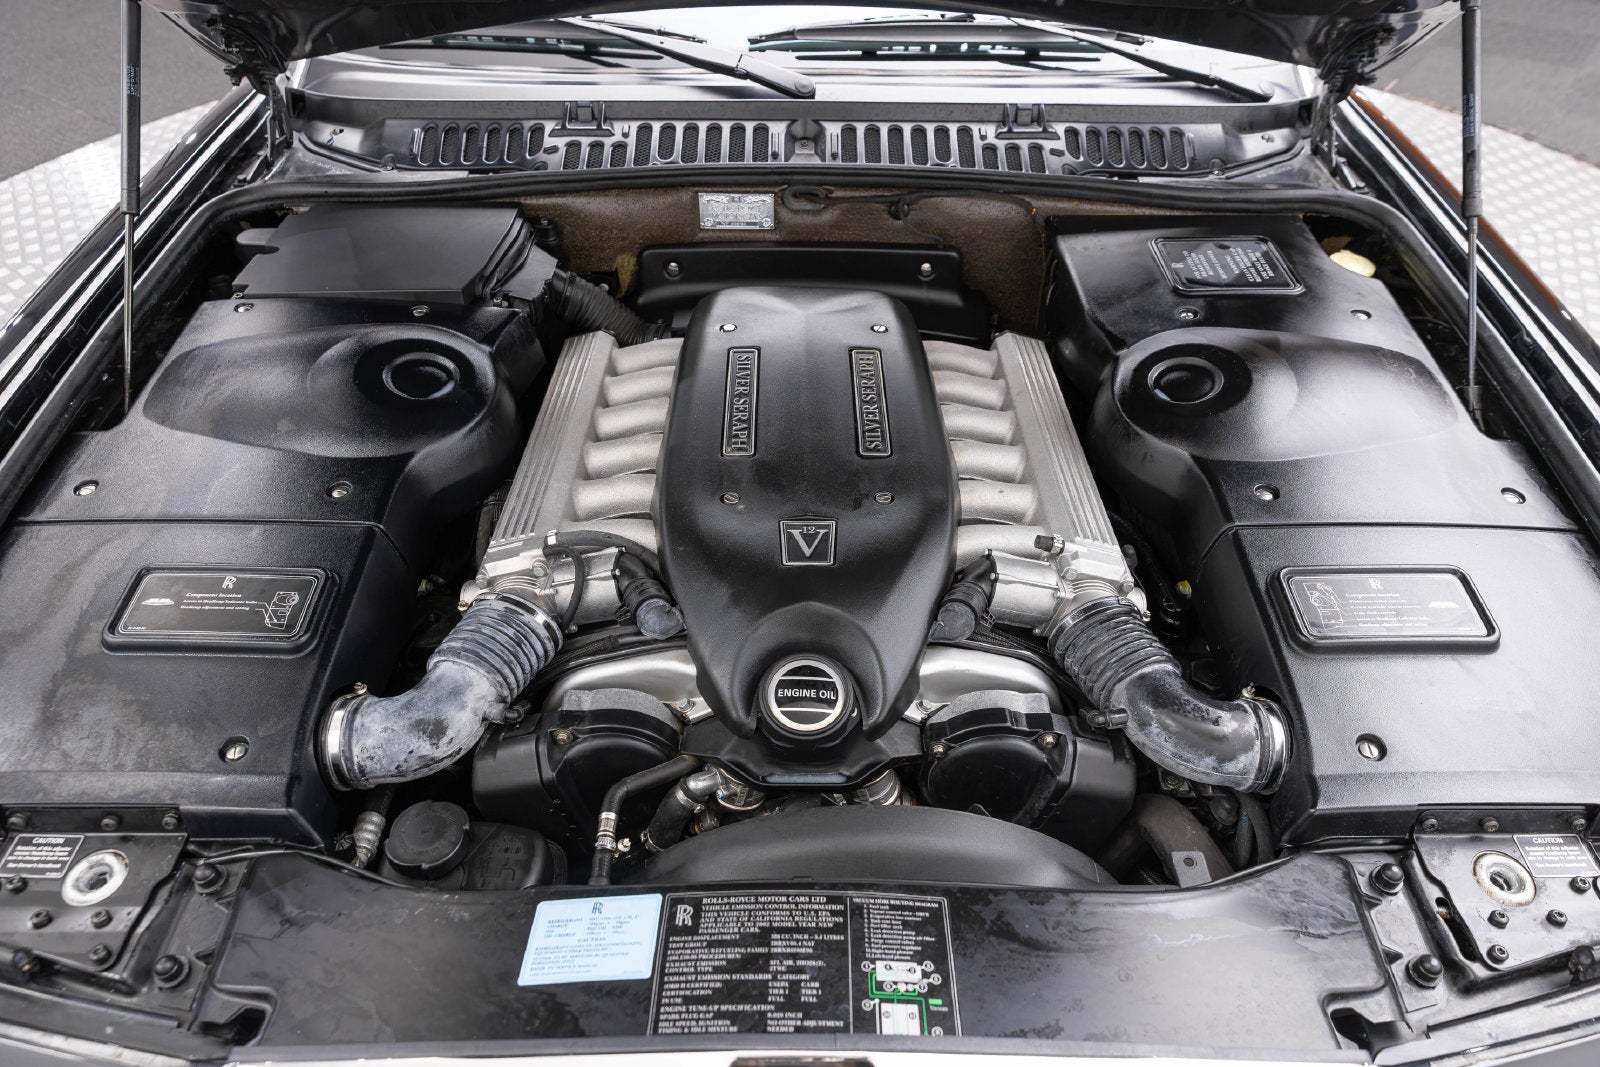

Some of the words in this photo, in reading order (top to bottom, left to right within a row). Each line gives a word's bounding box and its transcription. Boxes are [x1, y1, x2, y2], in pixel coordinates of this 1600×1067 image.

[735, 354, 751, 395] SILVER
[859, 355, 878, 401] SERAPH
[732, 396, 750, 451] SERAPH
[862, 401, 882, 451] SILVER
[777, 689, 816, 698] ENGINE
[818, 690, 836, 700] OIL
[702, 896, 757, 904] ROLLS-ROYCE
